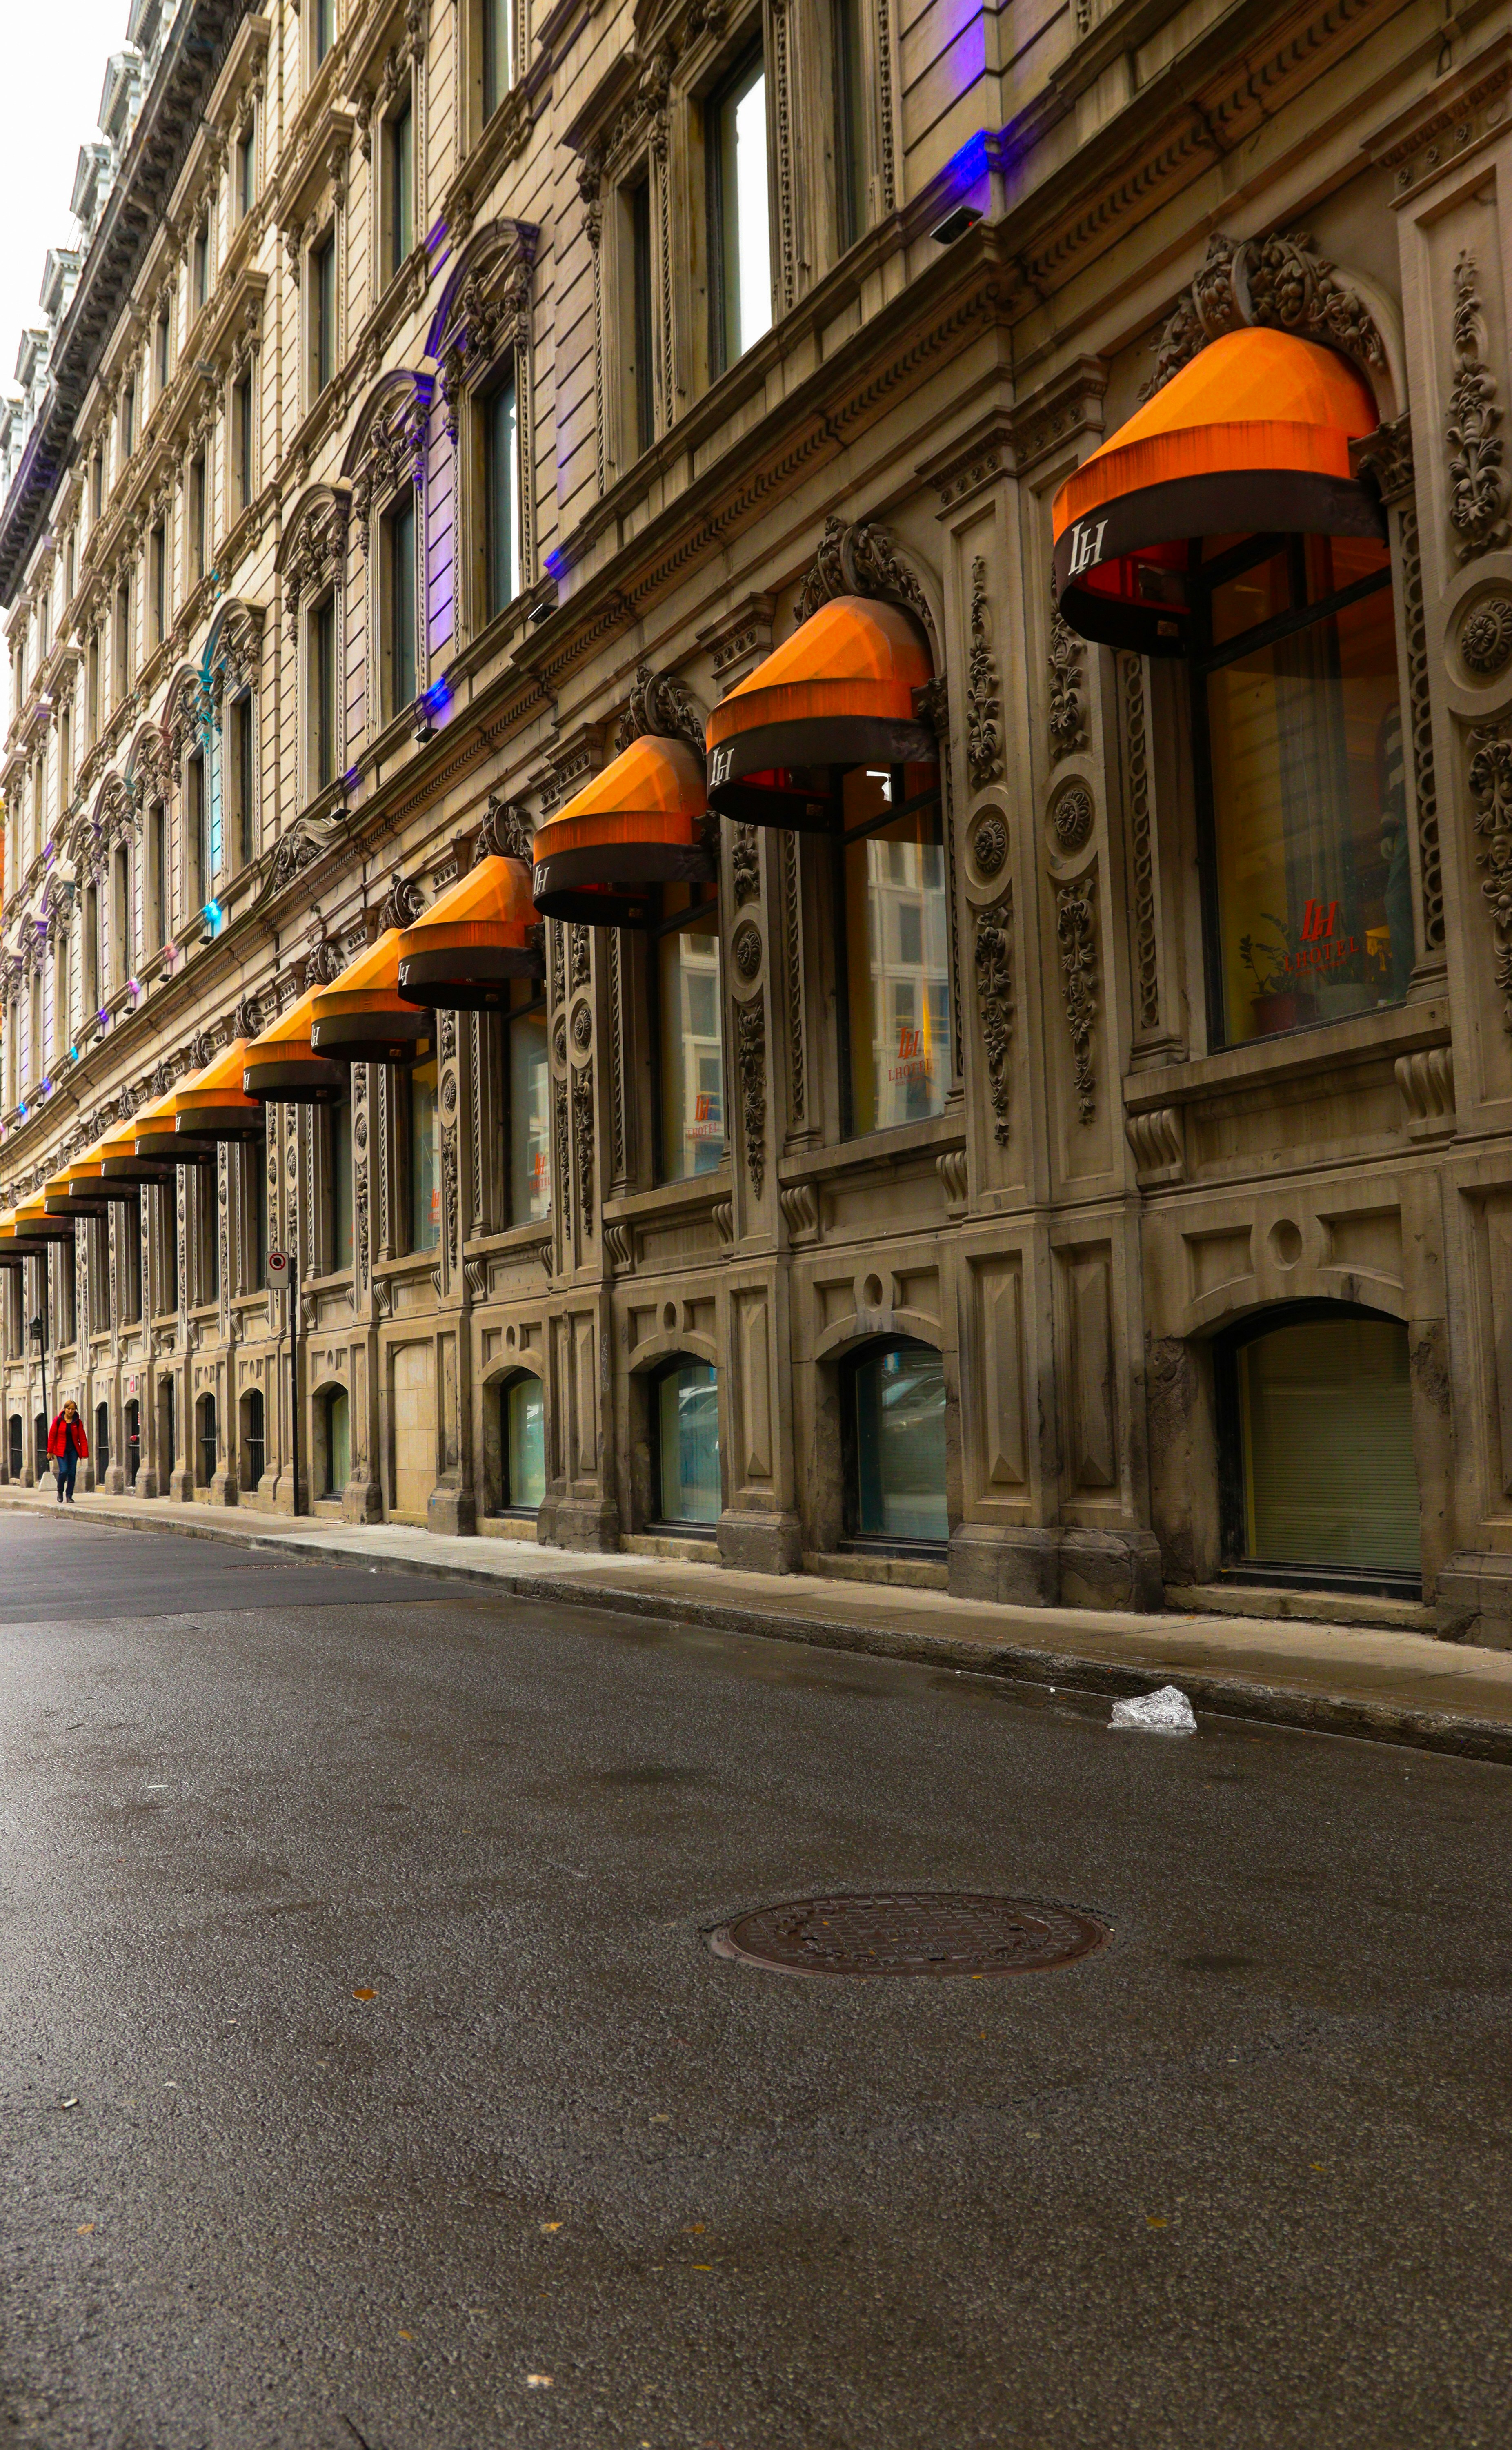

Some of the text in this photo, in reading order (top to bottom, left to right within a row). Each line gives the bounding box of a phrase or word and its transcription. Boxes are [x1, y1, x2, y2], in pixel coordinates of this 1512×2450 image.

[1068, 519, 1108, 576] LH
[709, 746, 735, 786] LH
[533, 864, 550, 896] LH
[1300, 898, 1339, 942] LH
[898, 1027, 920, 1060] LH
[694, 1094, 709, 1122] LH
[534, 1152, 545, 1176] LH
